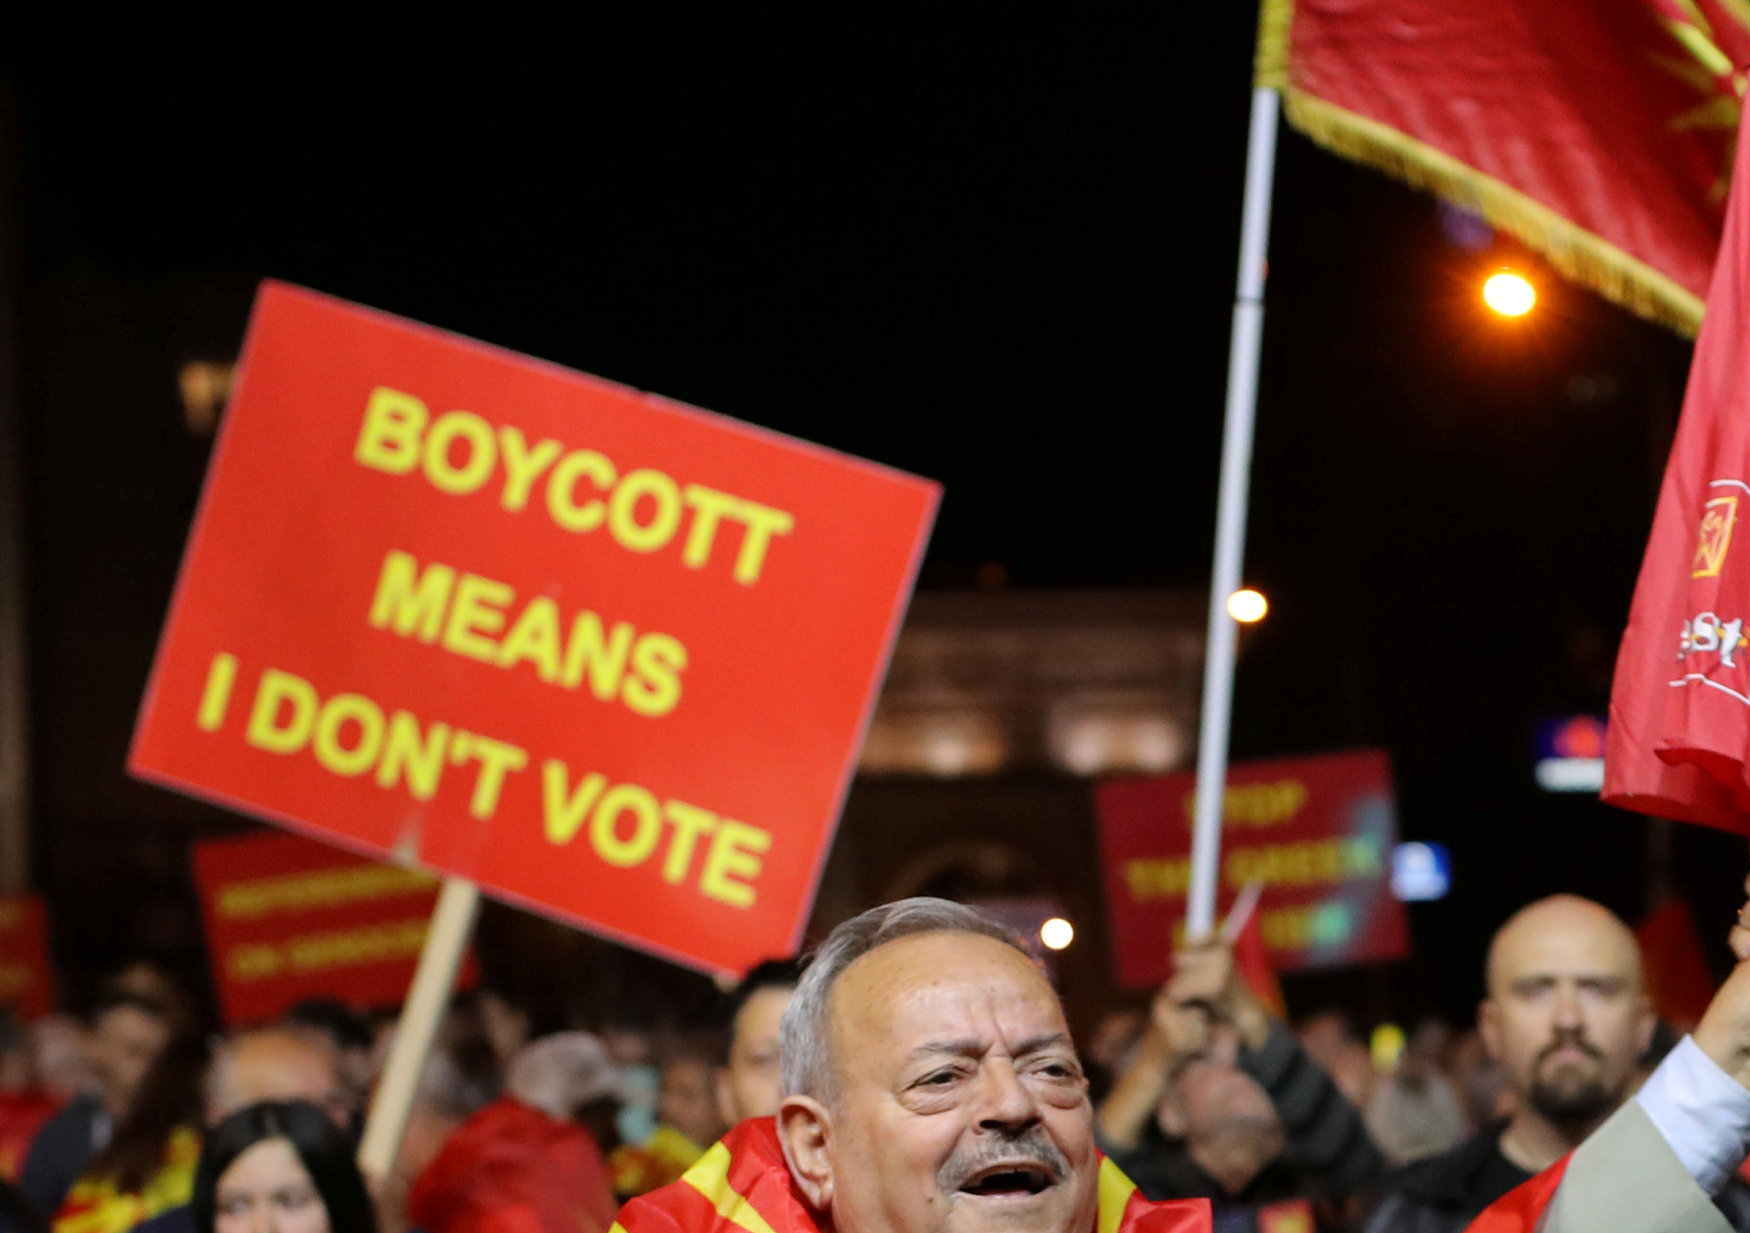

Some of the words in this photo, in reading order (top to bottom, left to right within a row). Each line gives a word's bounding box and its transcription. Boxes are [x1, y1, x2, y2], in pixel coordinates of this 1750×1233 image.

[355, 386, 796, 586] BOYCOTT
[370, 551, 688, 717] MEANS
[198, 653, 237, 731] I
[247, 669, 528, 819] DON'T
[542, 759, 774, 909] VOTE
